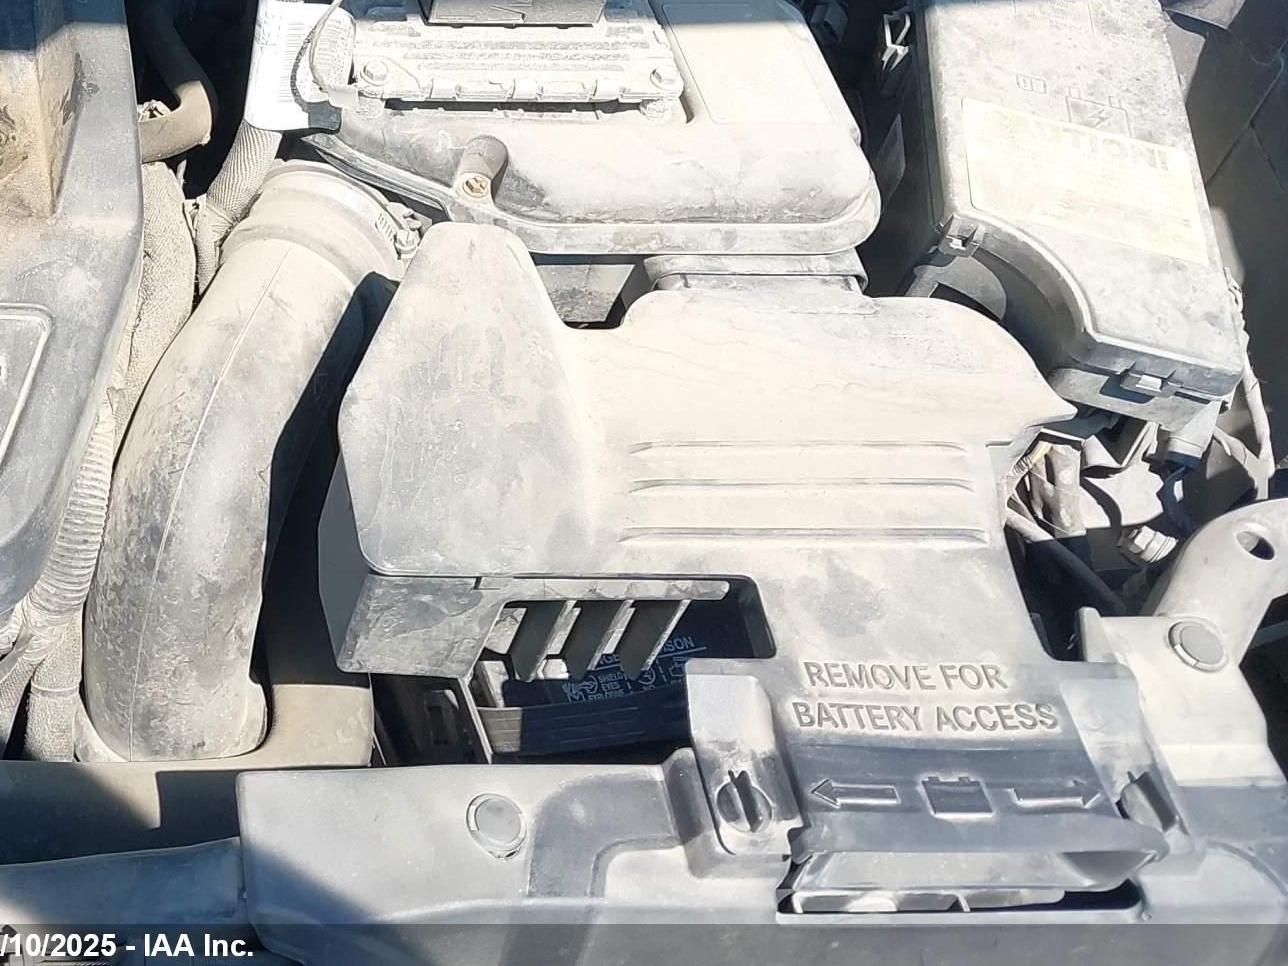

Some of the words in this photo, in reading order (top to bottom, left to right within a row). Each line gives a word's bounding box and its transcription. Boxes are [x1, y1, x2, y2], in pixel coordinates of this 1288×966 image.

[803, 661, 937, 690] REMOVE
[939, 663, 1009, 690] FOR
[791, 701, 923, 731] BATTERY
[935, 703, 1059, 732] ACCESS
